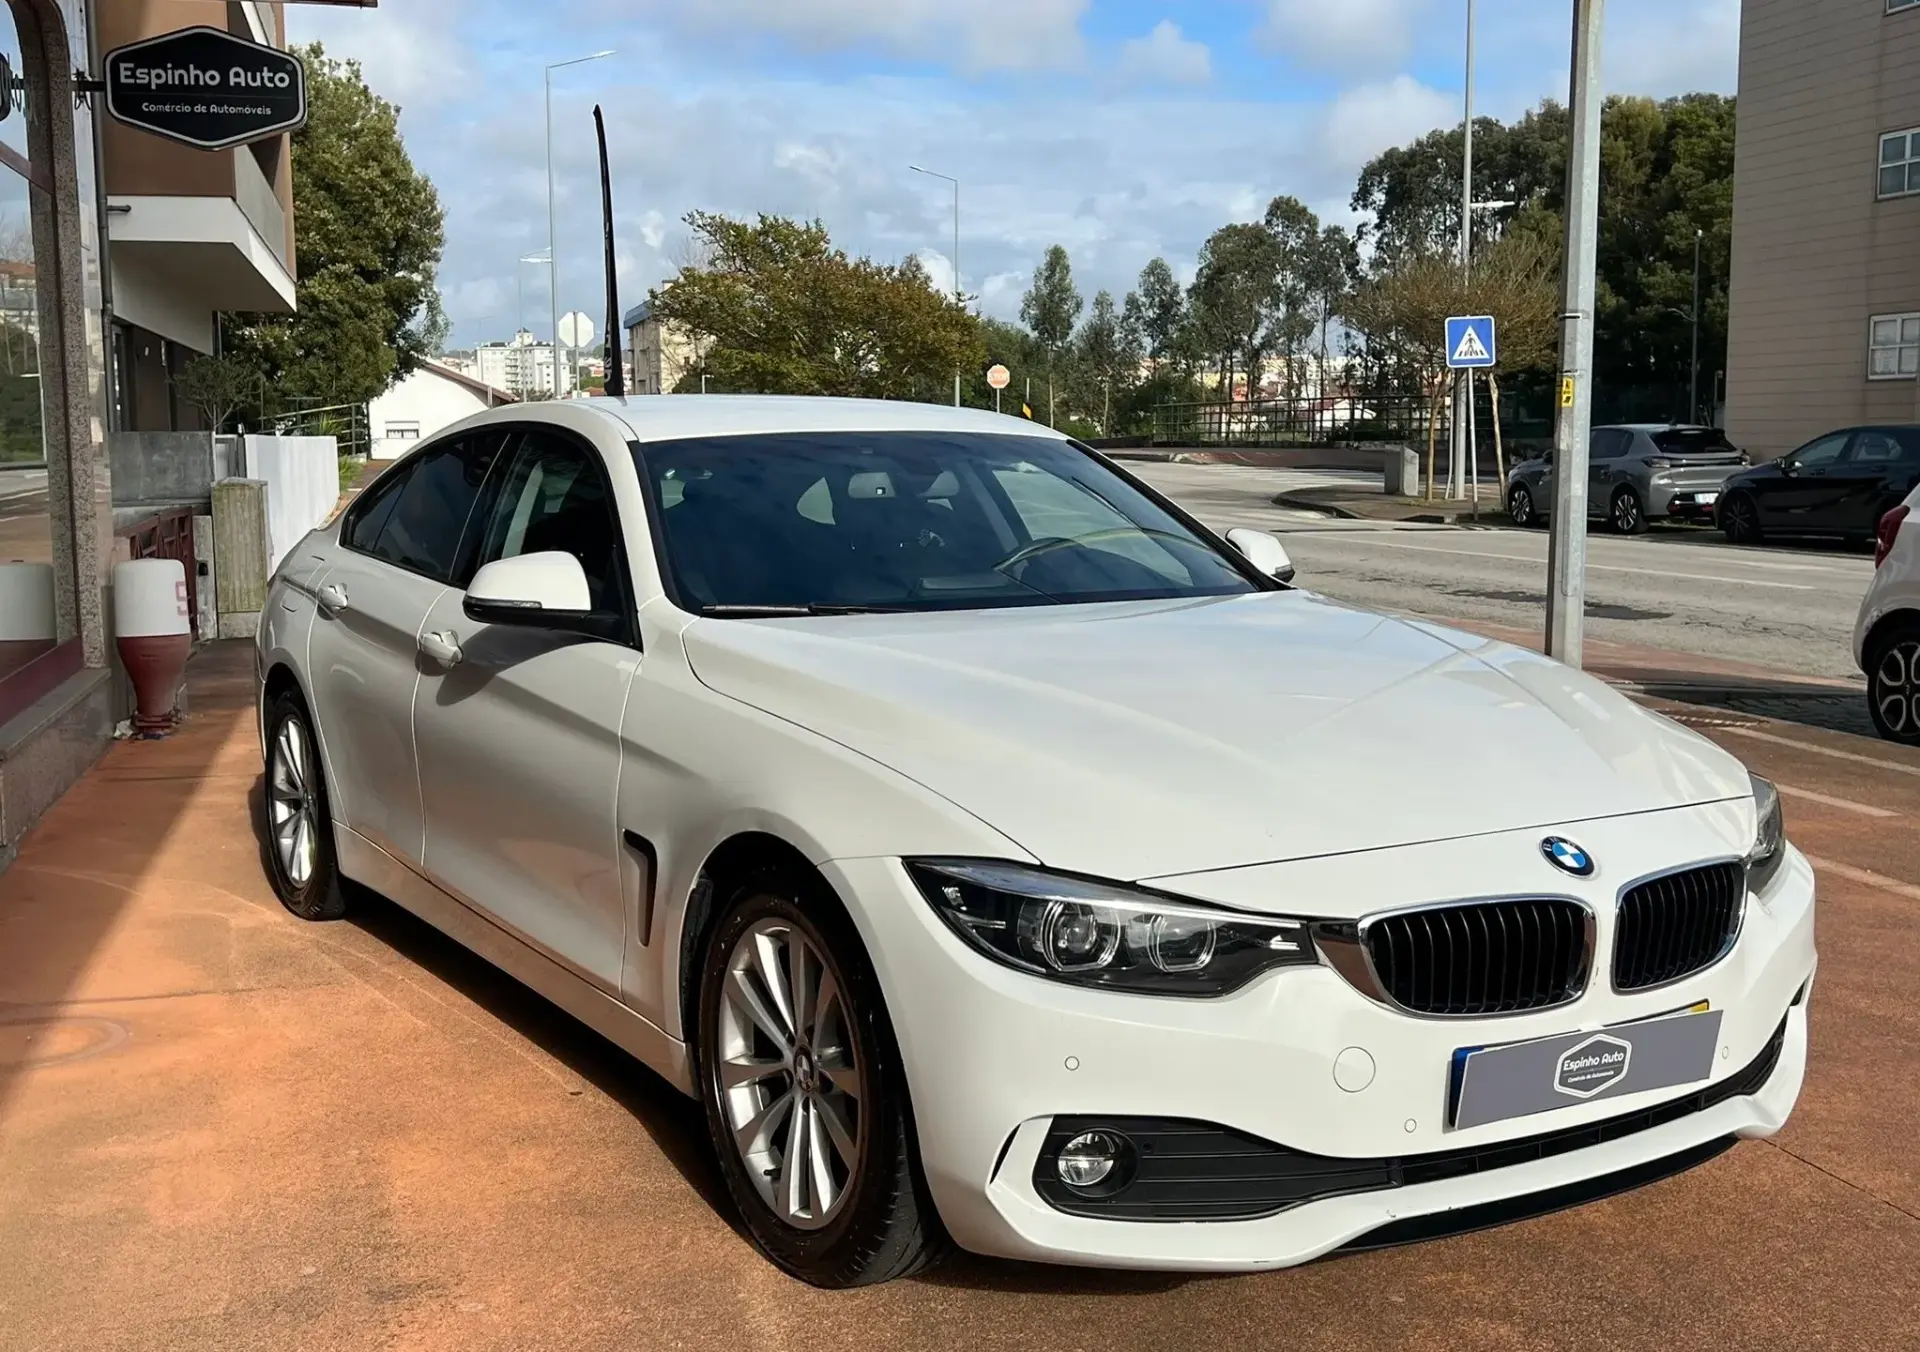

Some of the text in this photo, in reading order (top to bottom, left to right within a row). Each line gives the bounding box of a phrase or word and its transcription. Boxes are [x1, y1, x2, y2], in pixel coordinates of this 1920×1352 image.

[119, 62, 290, 90] Espinho Auto
[142, 102, 272, 115] Comércio de Automóveis
